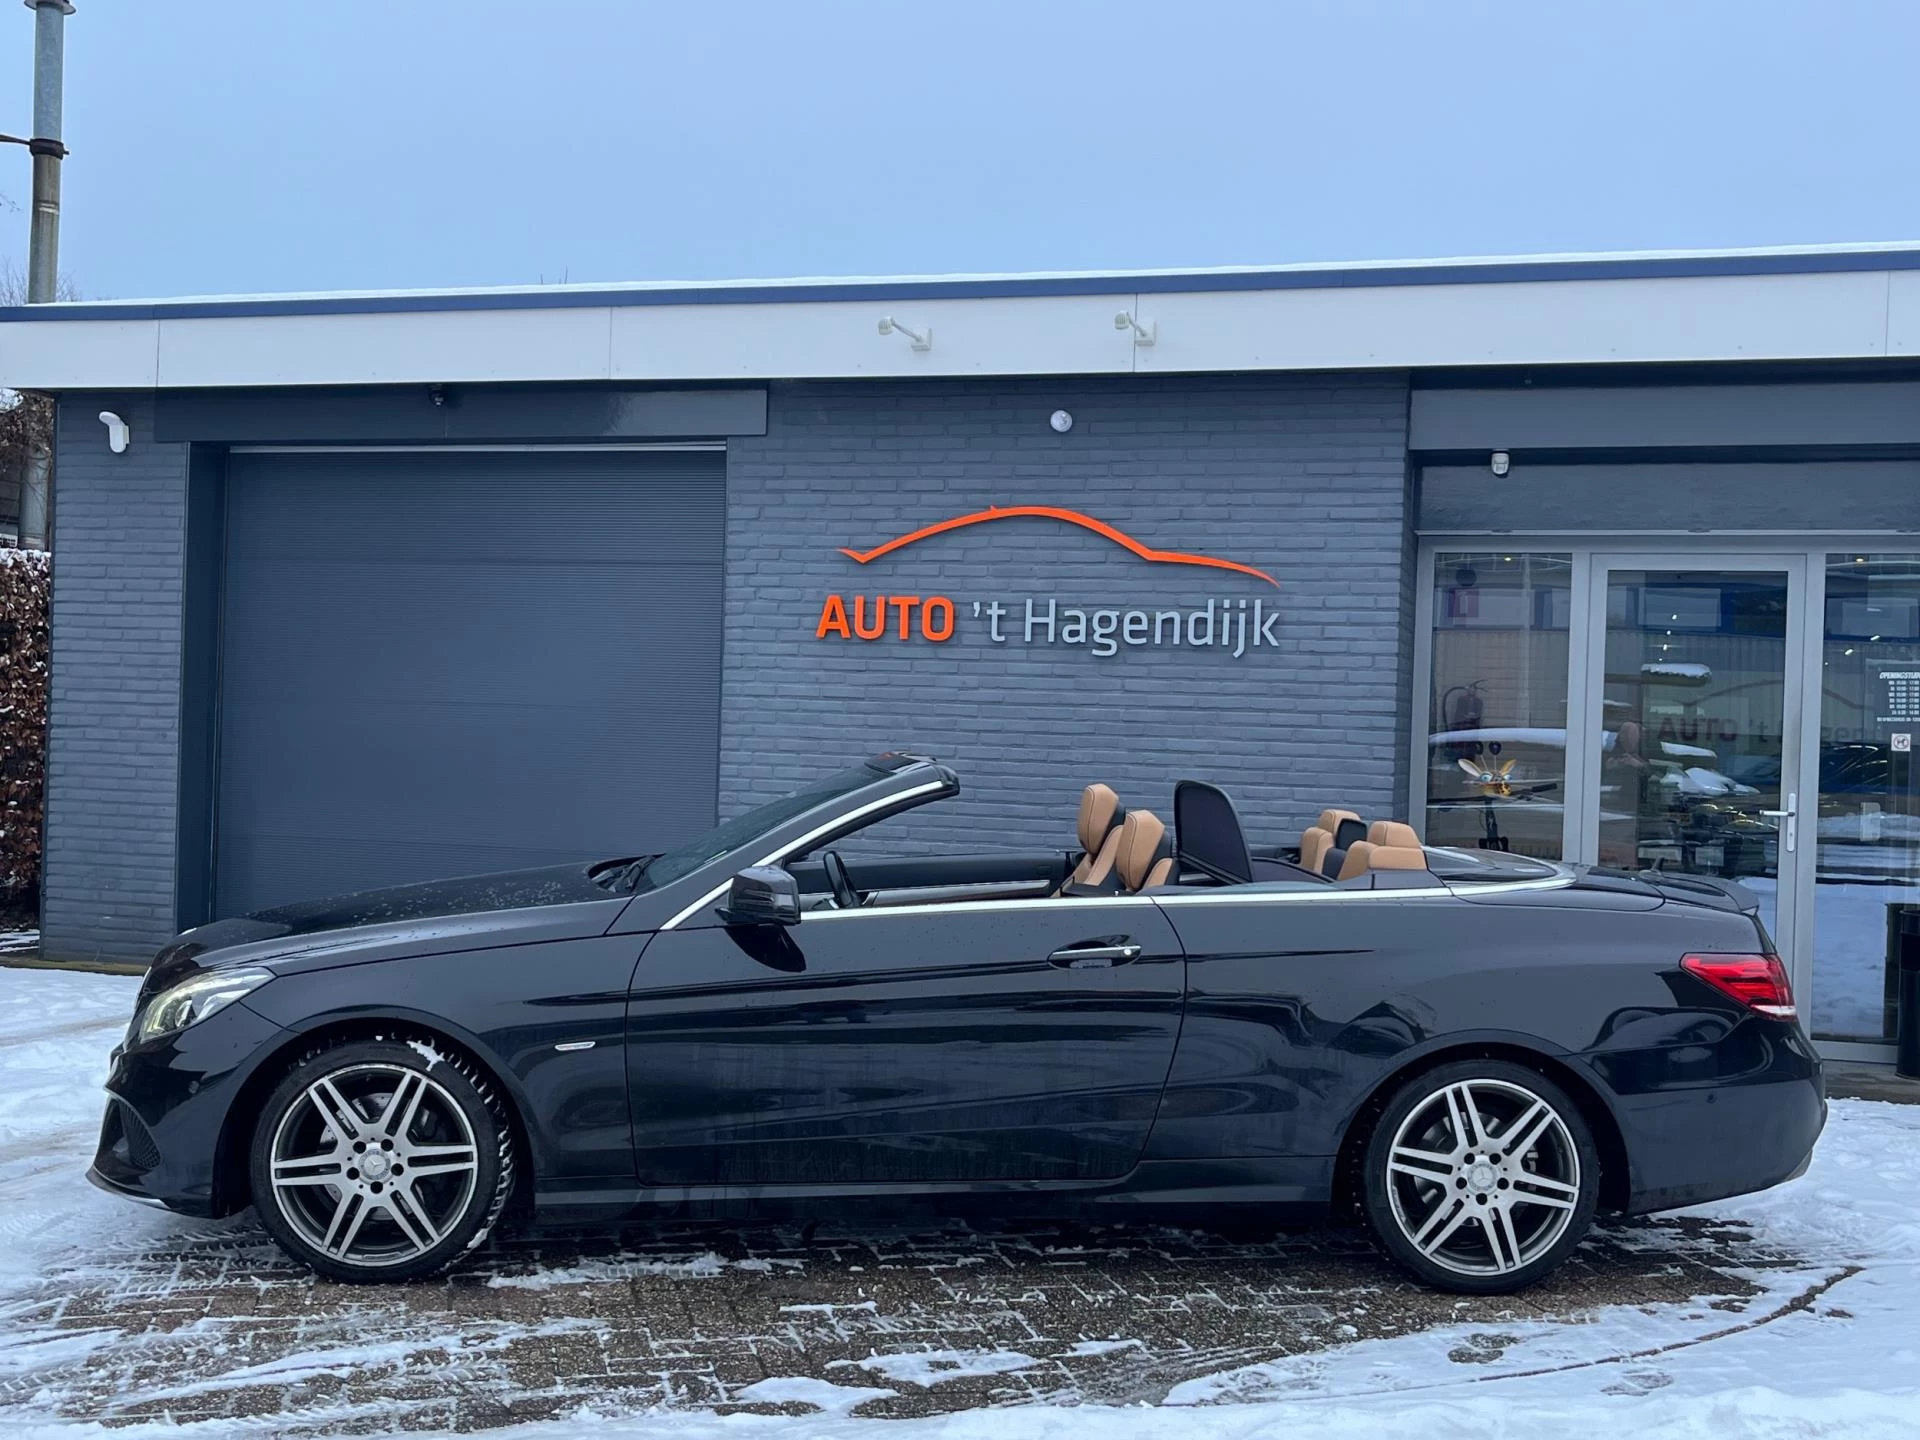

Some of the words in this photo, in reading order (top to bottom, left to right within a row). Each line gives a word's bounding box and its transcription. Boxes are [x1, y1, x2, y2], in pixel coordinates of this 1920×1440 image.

[816, 595, 954, 641] AUTO
[973, 600, 1006, 643] 't
[1024, 598, 1280, 658] Hagendijk
[1658, 717, 1738, 741] AUTO
